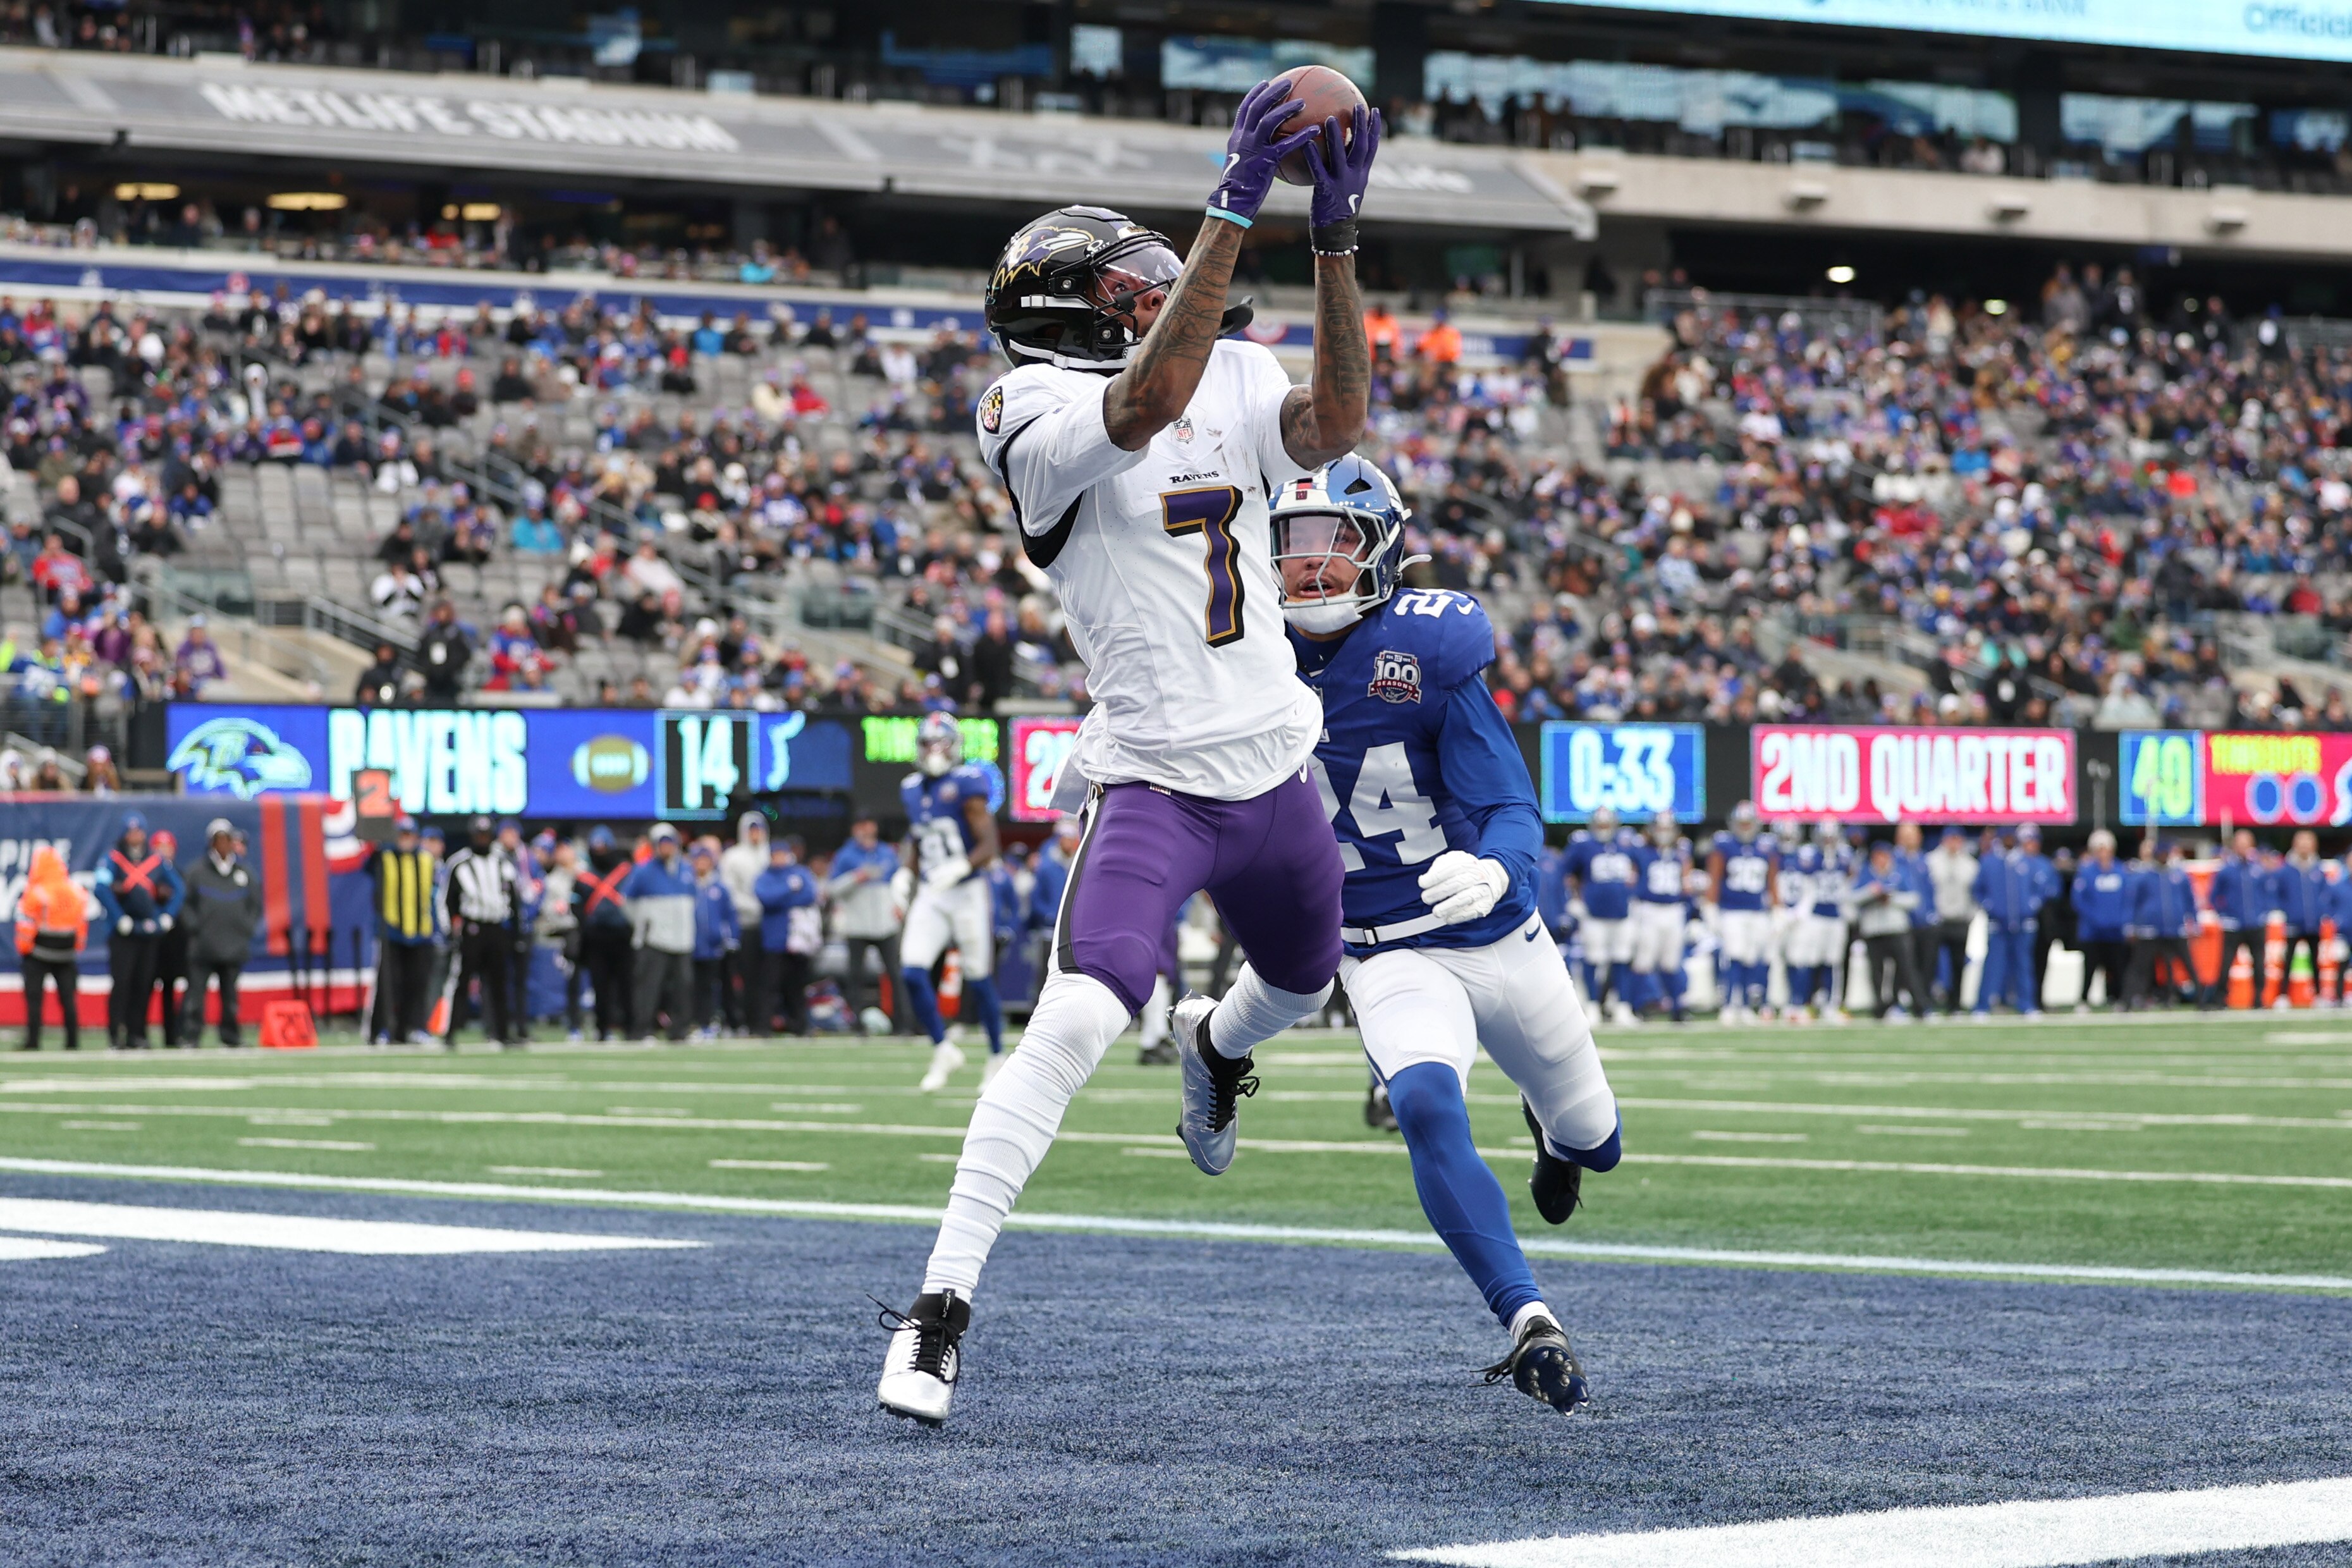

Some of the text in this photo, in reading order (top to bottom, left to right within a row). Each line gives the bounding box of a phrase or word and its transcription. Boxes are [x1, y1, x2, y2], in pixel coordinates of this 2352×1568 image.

[200, 82, 740, 154] METLIFE STADIUM
[1177, 428, 1192, 439] NFL
[1169, 471, 1220, 484] RAVENS
[1158, 485, 1245, 649] 7
[1393, 588, 1468, 618] 2
[1376, 660, 1418, 685] 100
[1377, 681, 1413, 691] SEASONS
[677, 714, 740, 811] 14
[1569, 726, 1675, 812] 0:33
[1761, 732, 2067, 822] 2ND QUARTER
[357, 770, 393, 818] 2
